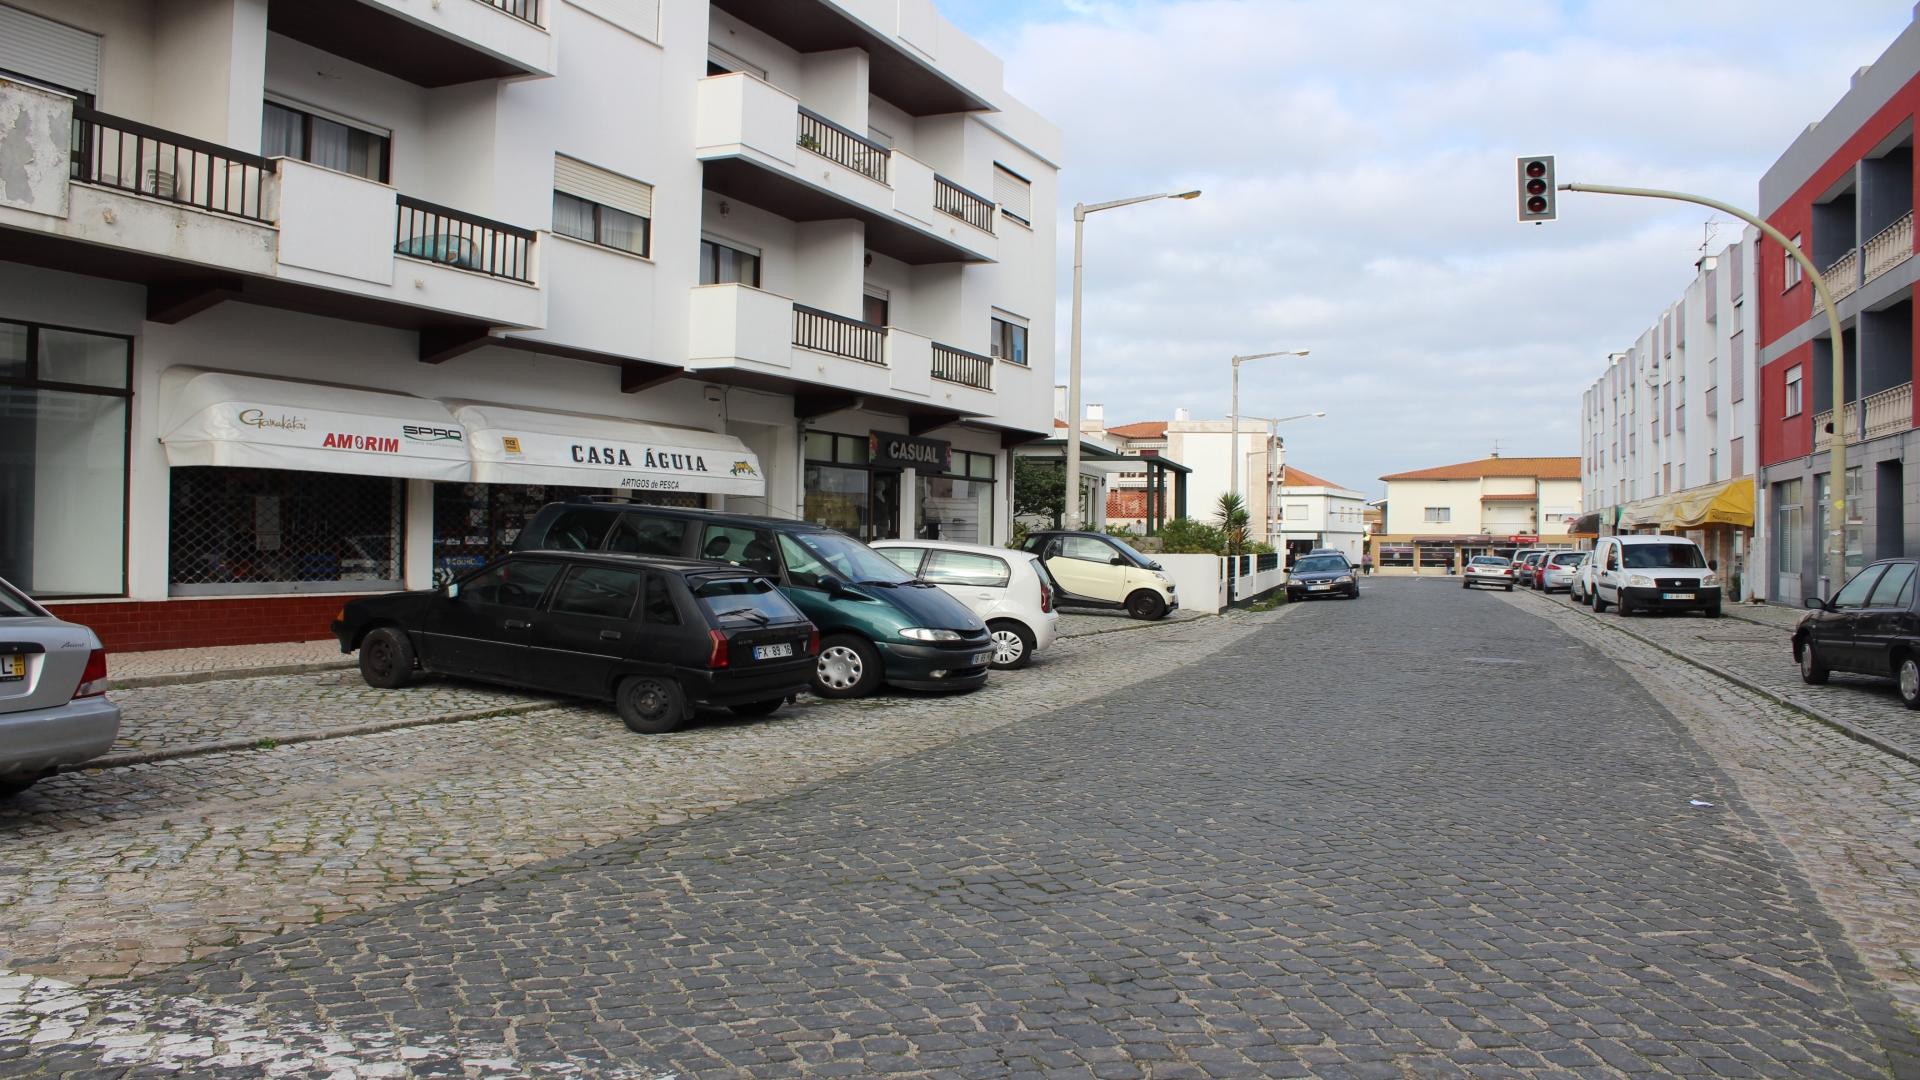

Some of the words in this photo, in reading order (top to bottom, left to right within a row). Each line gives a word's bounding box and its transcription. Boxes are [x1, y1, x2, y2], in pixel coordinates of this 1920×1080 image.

[322, 432, 399, 453] AMORIM
[403, 425, 462, 439] SPRO
[571, 445, 631, 466] CASA
[644, 448, 708, 472] ÁGUIA
[890, 441, 940, 463] CASUAL
[620, 478, 650, 489] ARTIGOS
[651, 481, 659, 489] de
[659, 480, 680, 490] PESCA
